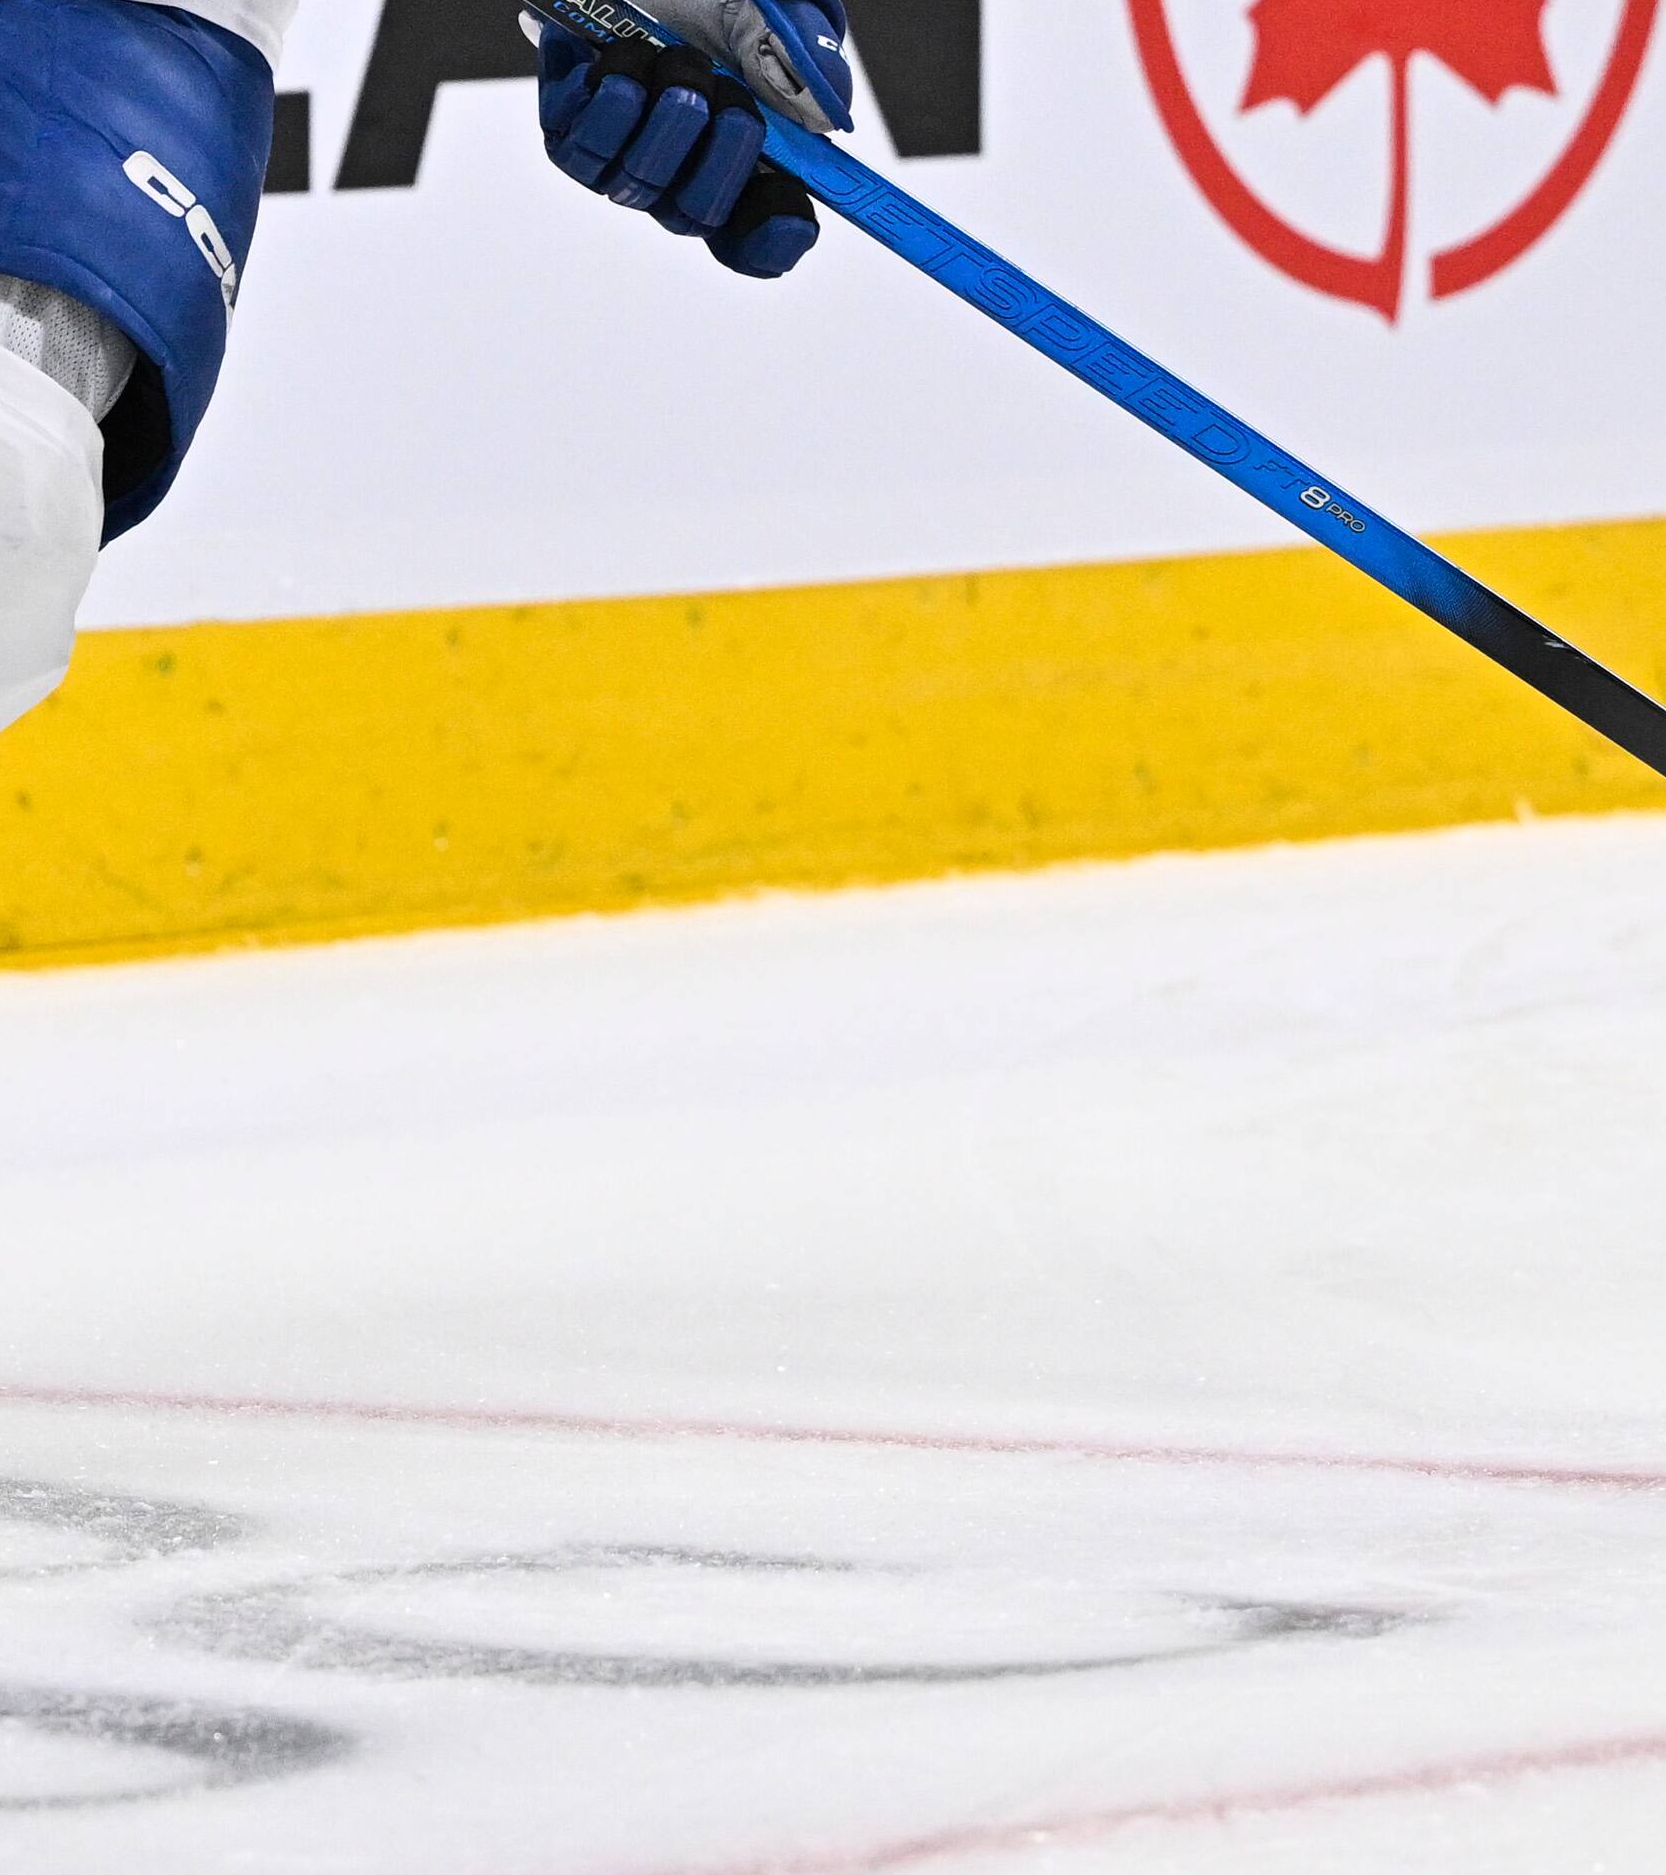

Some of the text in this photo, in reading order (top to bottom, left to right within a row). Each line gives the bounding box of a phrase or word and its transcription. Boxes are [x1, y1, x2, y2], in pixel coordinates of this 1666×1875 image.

[122, 150, 237, 333] CC
[810, 165, 1252, 466] JETSPEED
[1324, 503, 1367, 533] PRO
